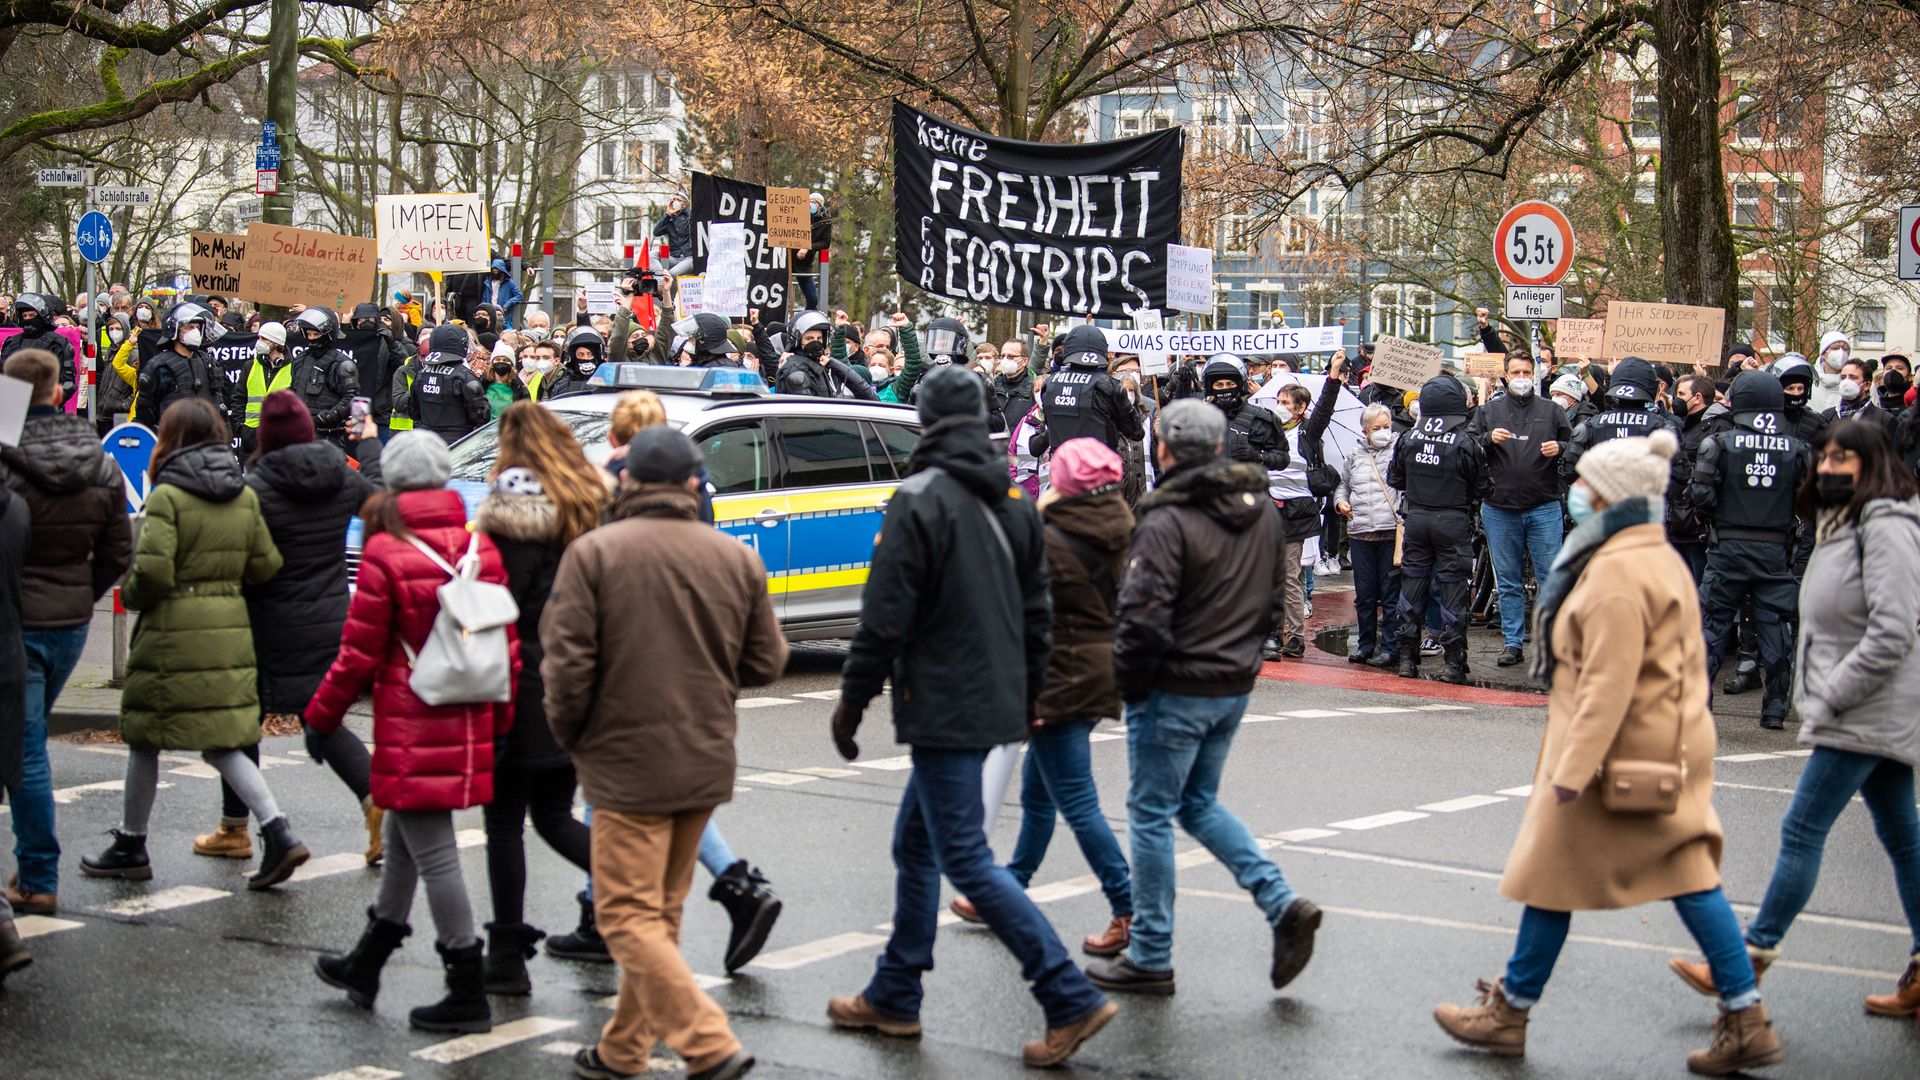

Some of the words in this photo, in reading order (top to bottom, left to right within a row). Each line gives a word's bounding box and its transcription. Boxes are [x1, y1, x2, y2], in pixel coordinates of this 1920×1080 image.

[41, 170, 82, 183] Schloßwall
[100, 190, 150, 203] Schloßstraße
[768, 193, 807, 206] GESUND-
[928, 158, 1161, 238] FREIHEIT
[718, 191, 767, 226] DIE
[779, 206, 795, 214] HEIT
[392, 201, 483, 233] IMPFEN
[772, 215, 783, 223] IST
[786, 216, 798, 224] EIN
[769, 227, 811, 241] GRUNDRECHT
[192, 236, 210, 259] Die
[270, 231, 366, 264] Solidarität
[400, 238, 479, 262] schützt
[214, 260, 228, 271] ist
[944, 227, 1152, 317] EGOTRIPS
[194, 272, 241, 293] vernün
[1169, 275, 1204, 289] GEGEN
[1512, 290, 1555, 303] Anlieger
[1526, 305, 1543, 315] frei
[1618, 305, 1644, 320] IHR
[1649, 307, 1675, 320] SEID
[1677, 310, 1699, 321] DER
[1143, 320, 1158, 330] OMAS
[1614, 324, 1691, 338] DUNNING-
[1118, 334, 1164, 351] OMAS
[1169, 335, 1225, 352] GEGEN
[1232, 332, 1299, 351] RECHTS
[1382, 336, 1402, 348] LASS
[1560, 345, 1592, 353] QUELLE
[425, 351, 441, 363] 62
[1081, 352, 1099, 364] 62
[1383, 353, 1426, 369] GESUNDHEIT
[1051, 372, 1093, 384] POLIZEI
[1374, 368, 1387, 377] SEI
[428, 376, 437, 385] NI
[422, 384, 440, 394] 6230
[1062, 386, 1073, 396] NI
[1615, 385, 1635, 398] 62
[1054, 395, 1076, 407] 6230
[1424, 417, 1444, 433] 62
[1599, 412, 1648, 426] POLIZEI
[1753, 412, 1777, 429] 62
[1616, 427, 1628, 438] NI
[1423, 443, 1435, 455] NI
[1735, 434, 1790, 452] POLIZEI
[1415, 452, 1440, 466] 6230
[1755, 452, 1769, 465] NI
[1745, 463, 1777, 477] 6230
